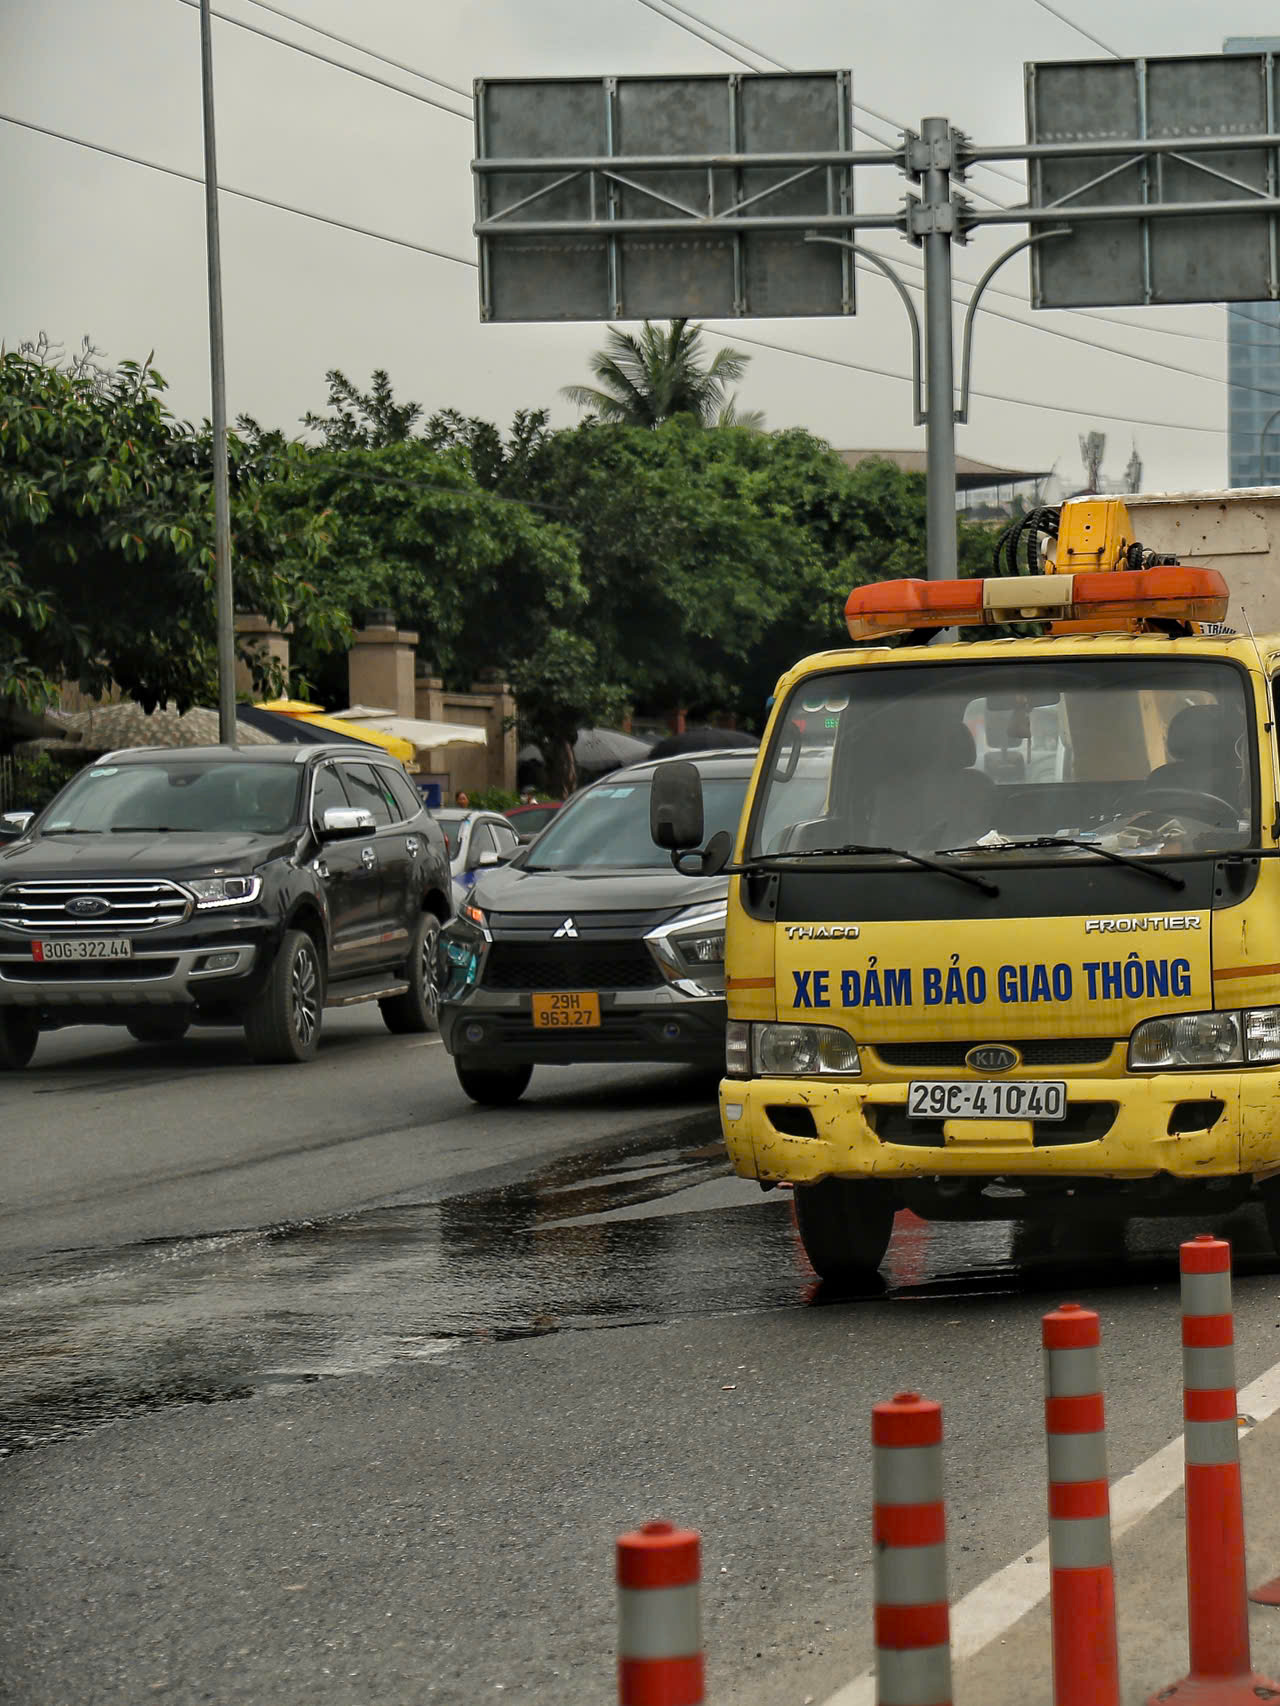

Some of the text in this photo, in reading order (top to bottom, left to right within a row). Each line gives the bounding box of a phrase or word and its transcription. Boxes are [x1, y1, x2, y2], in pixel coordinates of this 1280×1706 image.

[785, 926, 860, 940] THACO
[1085, 916, 1200, 934] FRONTIER
[44, 942, 129, 959] 30G-322.44
[792, 951, 1192, 1008] XE ĐẢM BẢO GIAO THÔNG
[550, 994, 580, 1009] 29H
[540, 1010, 592, 1026] 963.27
[976, 1052, 1010, 1066] KIA
